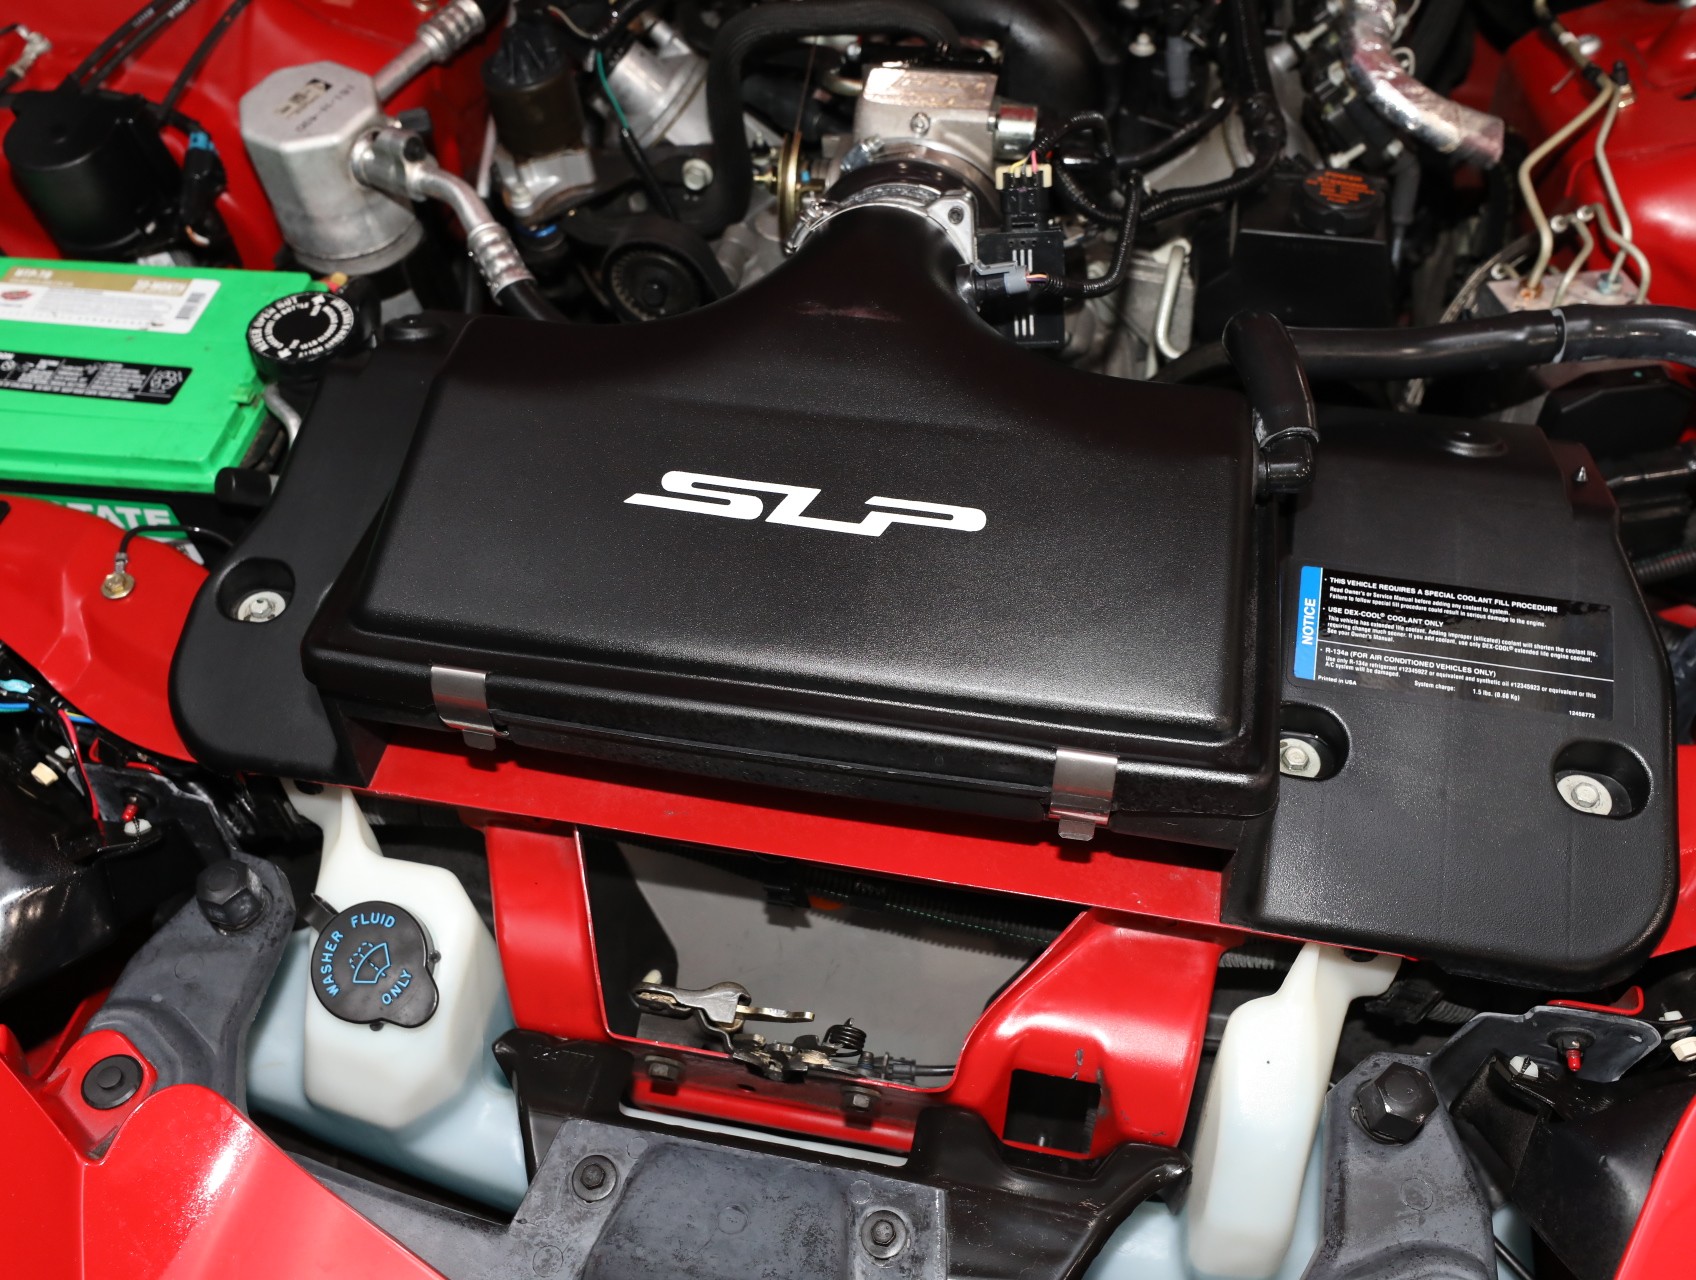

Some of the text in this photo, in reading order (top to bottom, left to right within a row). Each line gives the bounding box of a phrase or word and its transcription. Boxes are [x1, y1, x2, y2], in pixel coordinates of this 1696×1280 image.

[623, 471, 987, 537] SLP
[1344, 588, 1365, 596] Owner's
[1347, 580, 1377, 589] VEHICLE
[1379, 584, 1416, 594] REQUIRES
[1425, 590, 1455, 599] SPECIAL
[1457, 594, 1492, 603] COOLANT
[1511, 602, 1557, 612] PROCEDURE
[1302, 598, 1316, 645] NOTICE
[1387, 615, 1423, 624] COOLANT
[1351, 631, 1372, 639] Owner's
[1373, 634, 1394, 642] Manual.
[1428, 629, 1447, 637] Adding
[1325, 647, 1349, 656] R-134a
[1384, 656, 1434, 668] CONDITIONED
[1436, 663, 1472, 673] VEHICLES
[1474, 668, 1496, 677] ONLY)
[1374, 669, 1400, 677] damaged.
[1436, 672, 1464, 680] equivalent
[1415, 680, 1434, 688] System
[321, 912, 395, 996] WASHER FLUID
[382, 970, 411, 1004] ONLY
